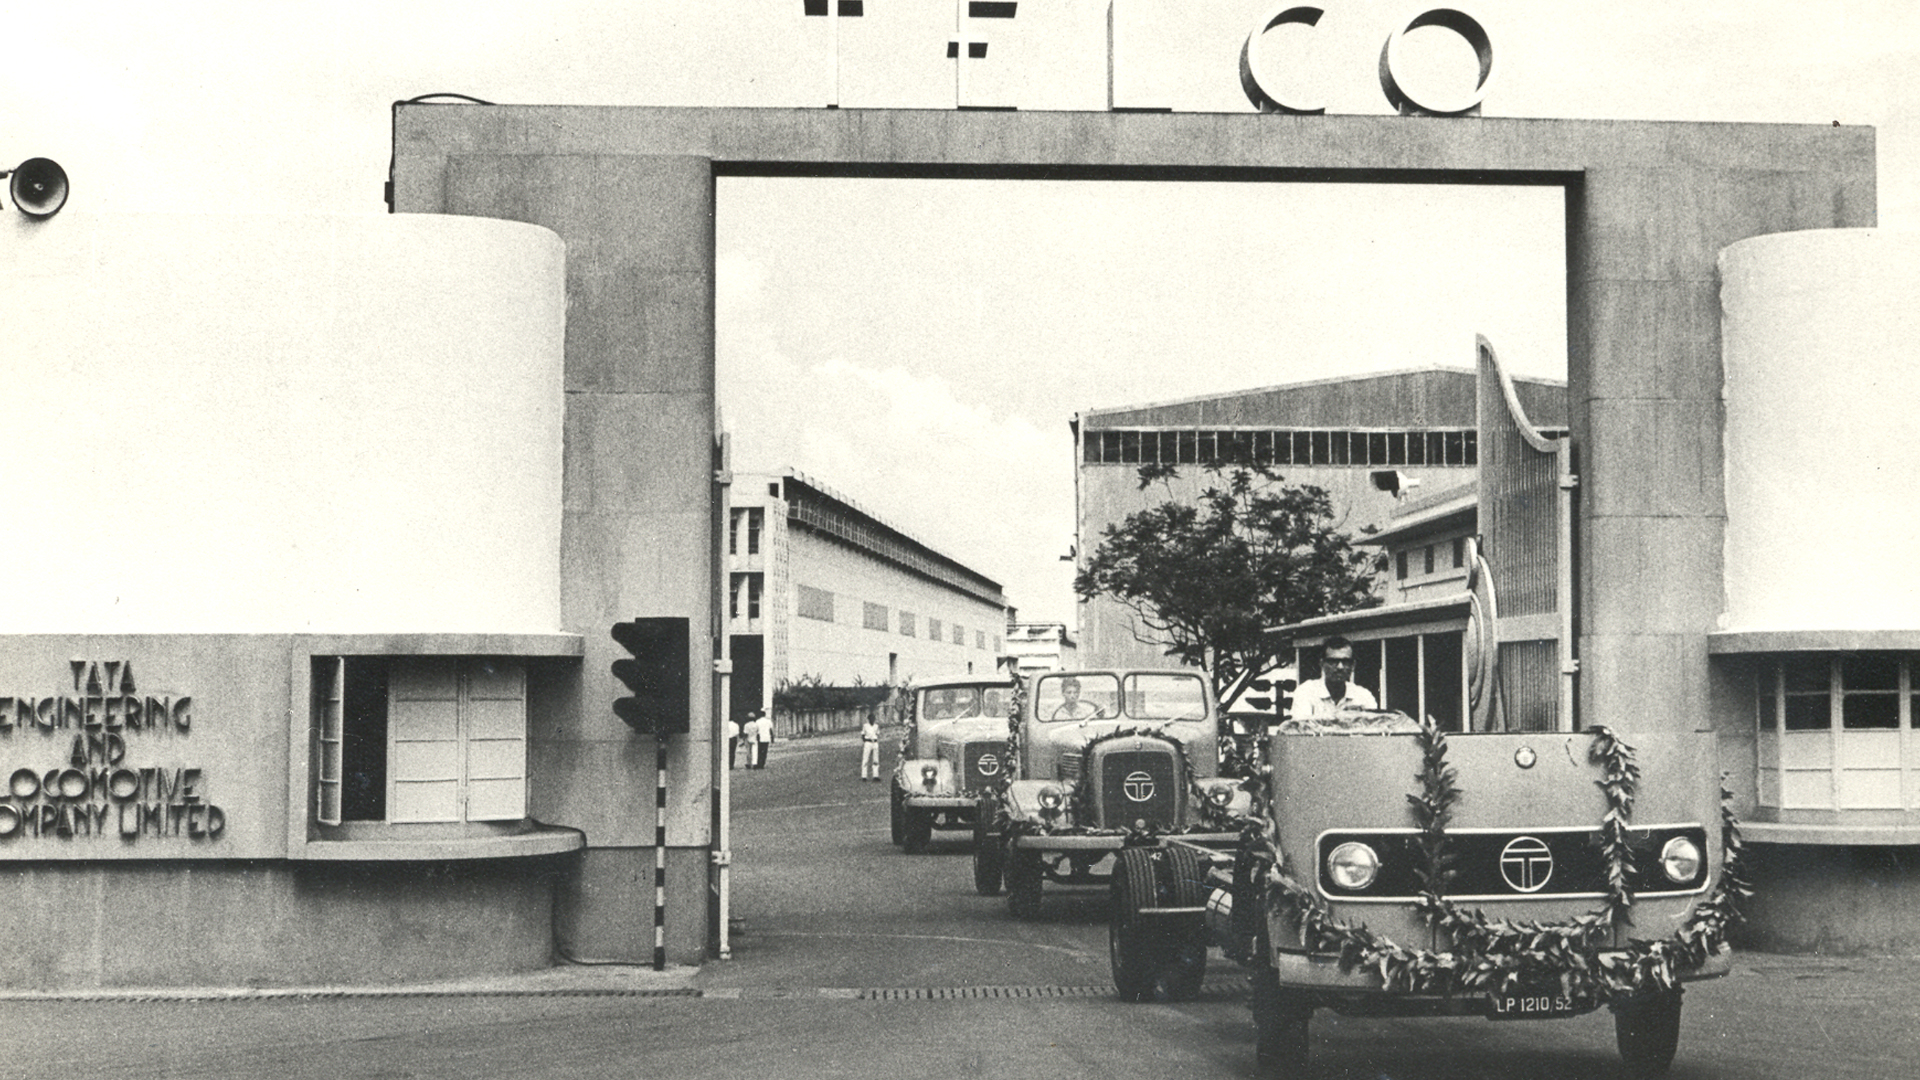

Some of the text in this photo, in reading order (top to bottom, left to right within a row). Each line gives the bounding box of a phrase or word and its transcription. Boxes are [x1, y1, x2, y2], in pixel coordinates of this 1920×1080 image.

[803, 0, 1493, 116] TELCO
[69, 660, 136, 693] TATA
[0, 696, 192, 732] ENGINEERING
[70, 733, 126, 766] AND
[0, 803, 226, 841] OMPANY LIMITED
[1497, 997, 1516, 1012] LP
